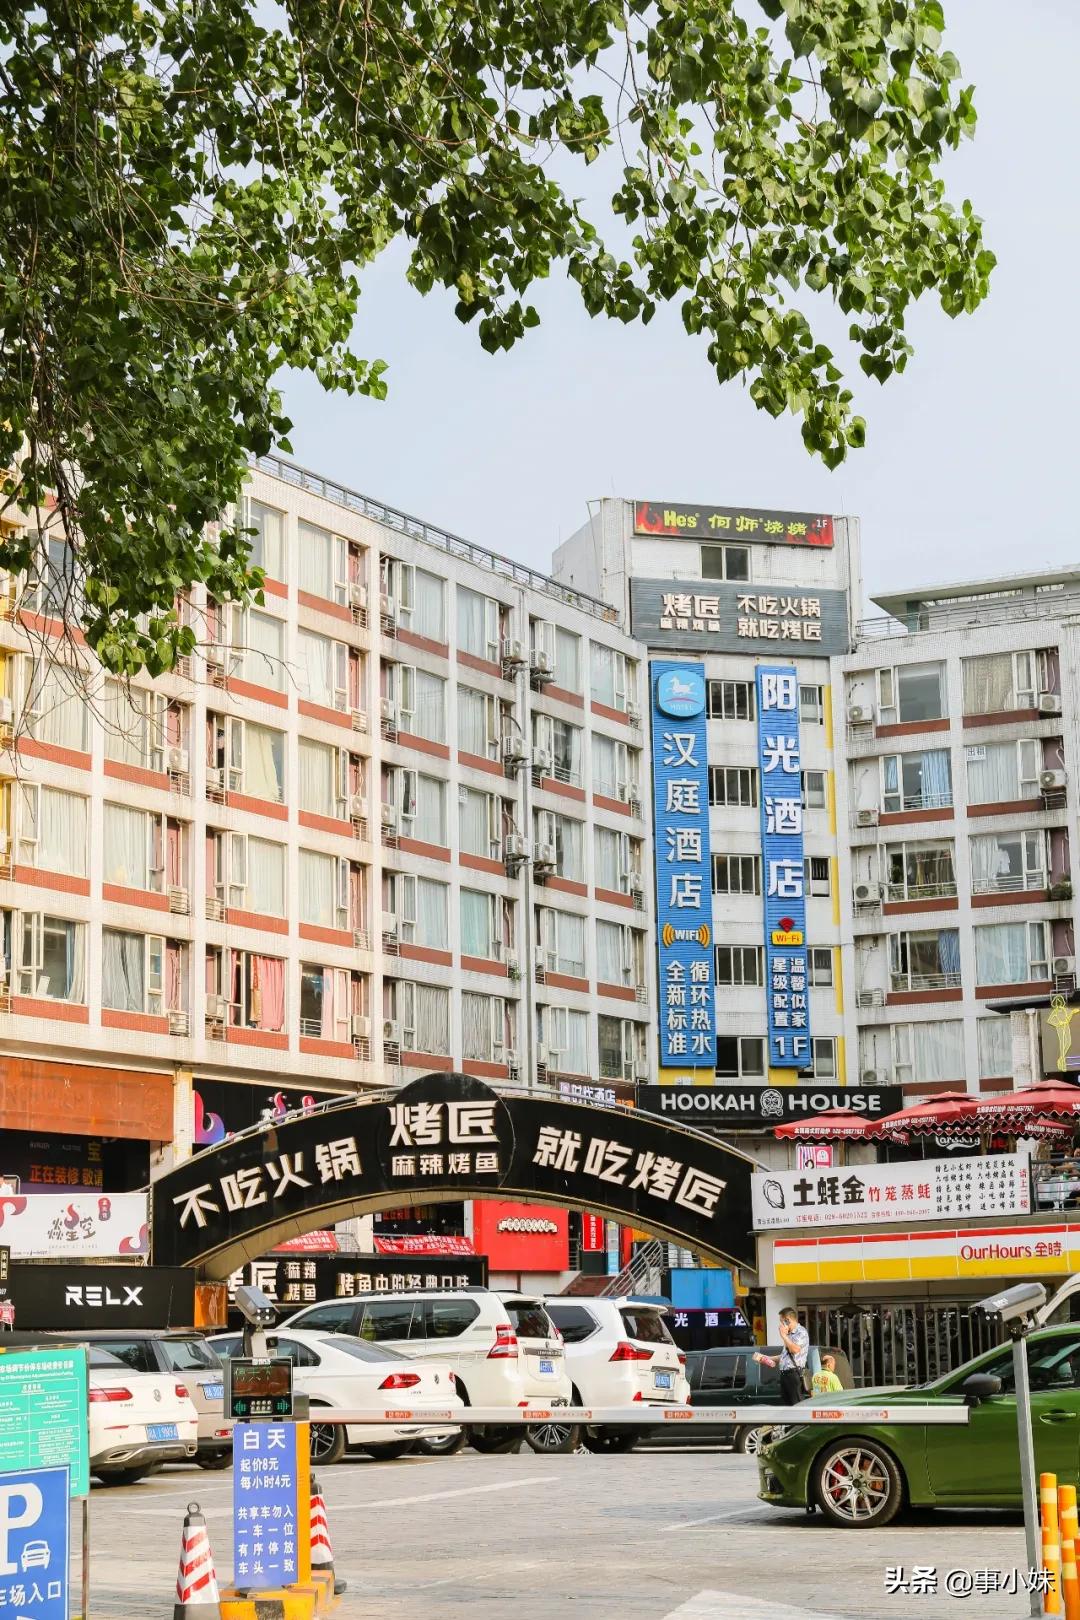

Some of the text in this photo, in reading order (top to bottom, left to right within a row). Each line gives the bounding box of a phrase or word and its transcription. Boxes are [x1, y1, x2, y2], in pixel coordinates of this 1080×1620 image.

[663, 593, 721, 619] 烤匠
[737, 594, 822, 618] 不吃火锅
[738, 618, 822, 642] 就吃烤匠
[762, 674, 804, 898] 阳光酒店
[663, 732, 703, 908] 汉庭酒店
[772, 957, 789, 1028] 星级配置
[790, 957, 807, 1028] 温馨似家
[666, 960, 688, 1056] 全新标准
[689, 960, 712, 1056] 循环热水
[774, 1036, 808, 1057] 1F
[661, 1093, 881, 1111] HOOKAH HOUSE
[388, 1101, 500, 1147] 烤匠
[30, 1164, 79, 1184] 正在装修
[391, 1153, 499, 1177] 麻辣烤鱼
[532, 1126, 728, 1219] 就吃烤匠
[173, 1136, 363, 1230] 不吃火锅
[793, 1175, 865, 1207] 土蚝金
[868, 1184, 931, 1202] 竹笼蒸蚝
[1019, 1168, 1028, 1209] 请上二楼
[961, 1241, 1062, 1260] OurHours 全時
[287, 1261, 317, 1279] 麻辣
[65, 1286, 143, 1306] RELX
[286, 1283, 317, 1301] 烤鱼
[337, 1272, 470, 1297] 烤鱼中的经典口味
[243, 1429, 286, 1450] 白天
[240, 1458, 279, 1472] 起价8元
[240, 1475, 291, 1490] 每小时4元
[238, 1505, 294, 1520] 共享车勿入
[0, 1482, 43, 1577] P
[238, 1522, 294, 1537] 一车一位
[238, 1541, 294, 1556] 有序停放
[238, 1559, 294, 1575] 车头一致
